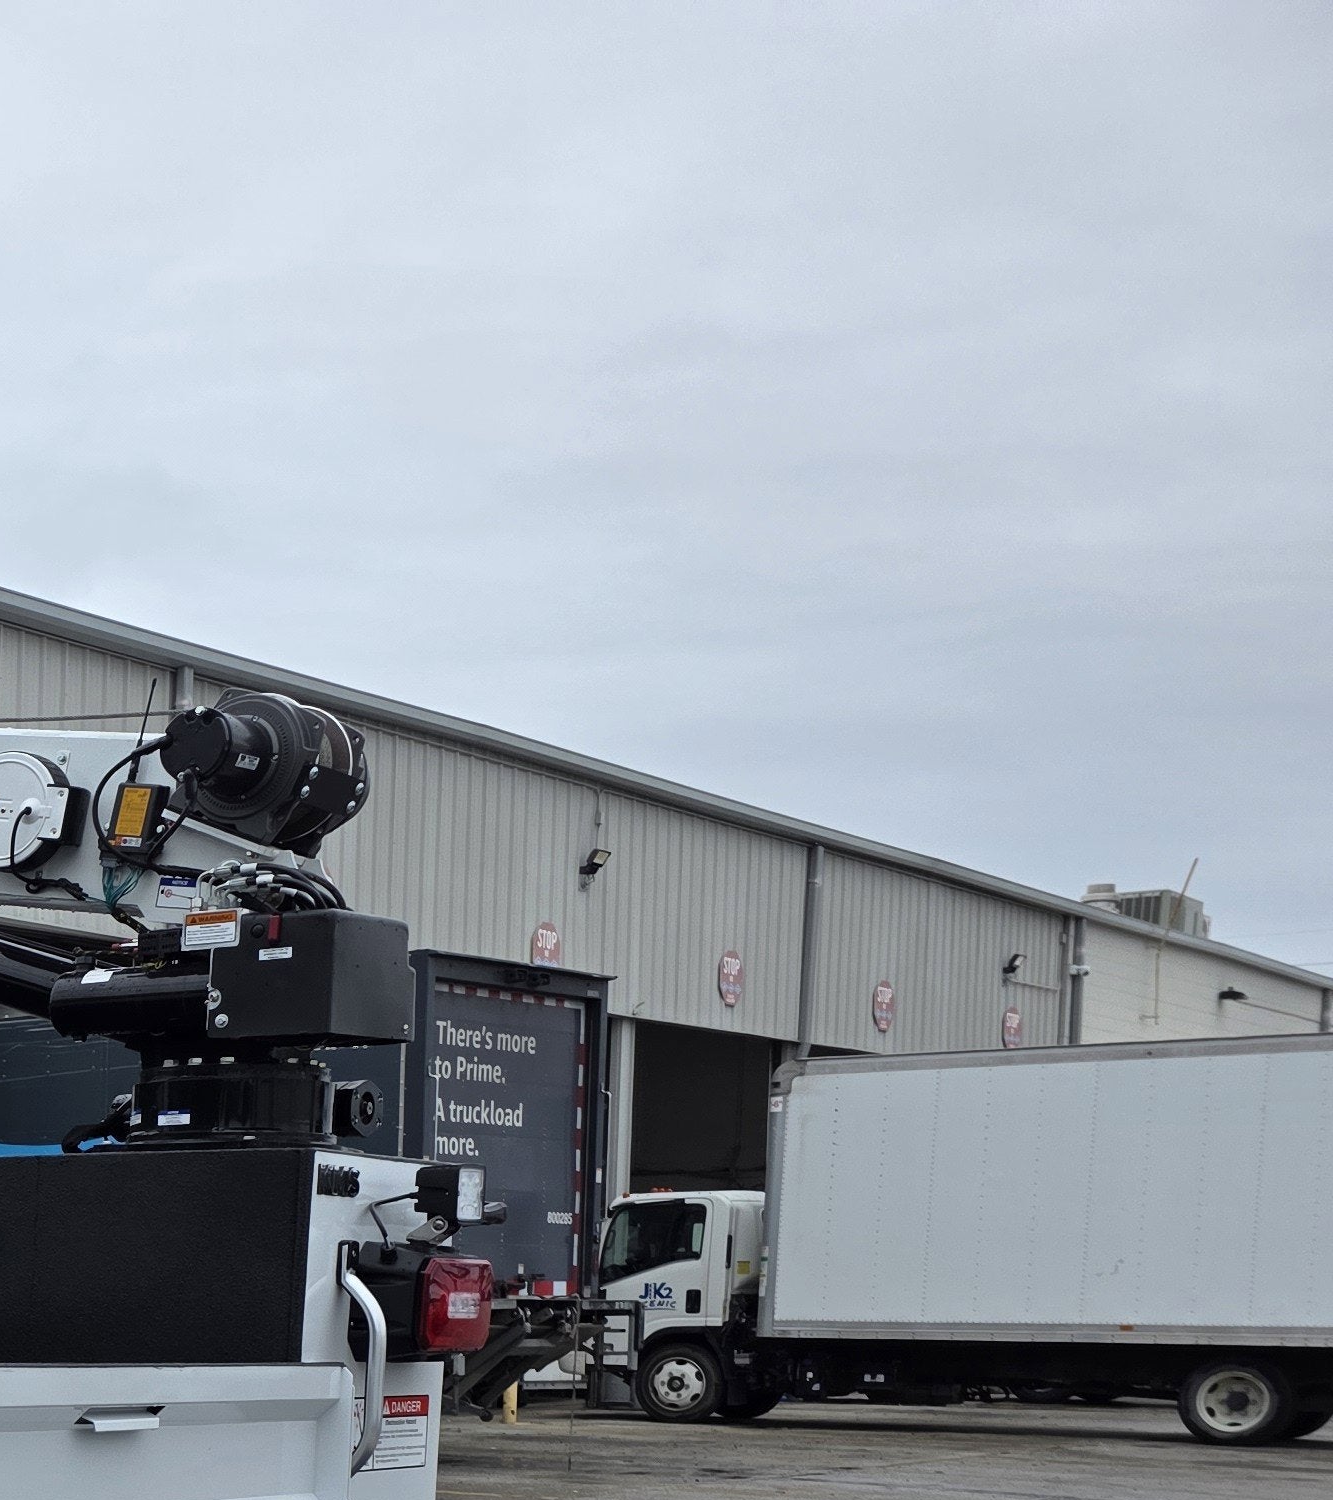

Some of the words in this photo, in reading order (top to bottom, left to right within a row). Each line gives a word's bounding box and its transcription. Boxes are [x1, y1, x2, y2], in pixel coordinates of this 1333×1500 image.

[198, 914, 233, 923] WARNING
[537, 928, 558, 950] STOP
[723, 956, 740, 976] STOP
[435, 1020, 493, 1049] There's
[496, 1032, 537, 1054] more
[434, 1055, 452, 1079] to
[456, 1056, 507, 1085] Prime.
[435, 1097, 446, 1122] A
[449, 1099, 524, 1127] truckload
[435, 1135, 480, 1157] more.
[391, 1401, 421, 1413] DANGER
